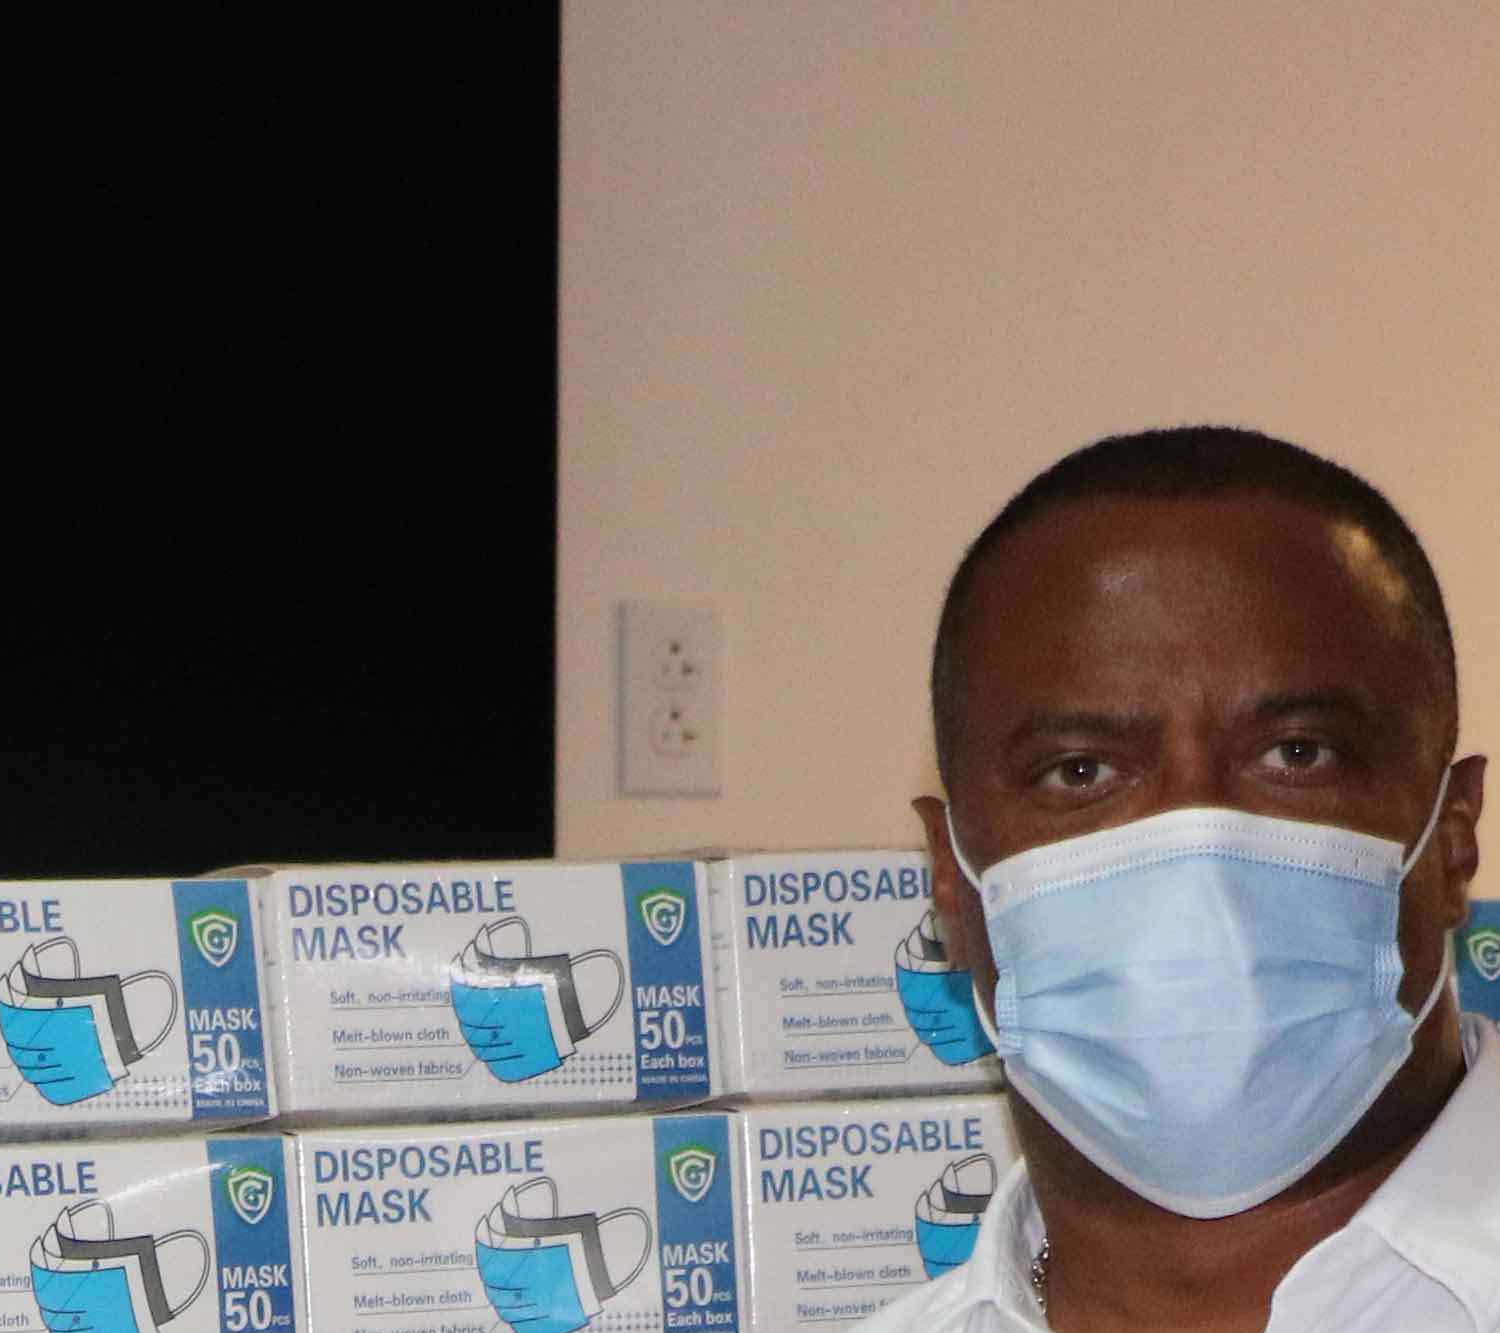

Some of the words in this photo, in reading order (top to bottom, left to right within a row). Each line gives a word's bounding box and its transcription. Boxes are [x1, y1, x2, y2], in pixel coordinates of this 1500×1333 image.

[289, 879, 516, 917] DISPOSABLE
[744, 868, 934, 906] DISPOSABL
[293, 924, 406, 961] MASK
[747, 911, 854, 950] MASK
[636, 985, 701, 1009] MASK
[189, 1007, 256, 1031] MASK
[638, 1009, 686, 1050] 50
[191, 1032, 241, 1073] 50
[760, 1117, 983, 1160] DISPOSABLE
[314, 1140, 544, 1183] DISPOSABLE
[762, 1164, 873, 1203] MASK
[317, 1188, 431, 1227] MASK
[664, 1241, 729, 1267] MASK
[221, 1264, 288, 1290] MASK
[665, 1266, 713, 1308] 50
[224, 1289, 272, 1332] 50
